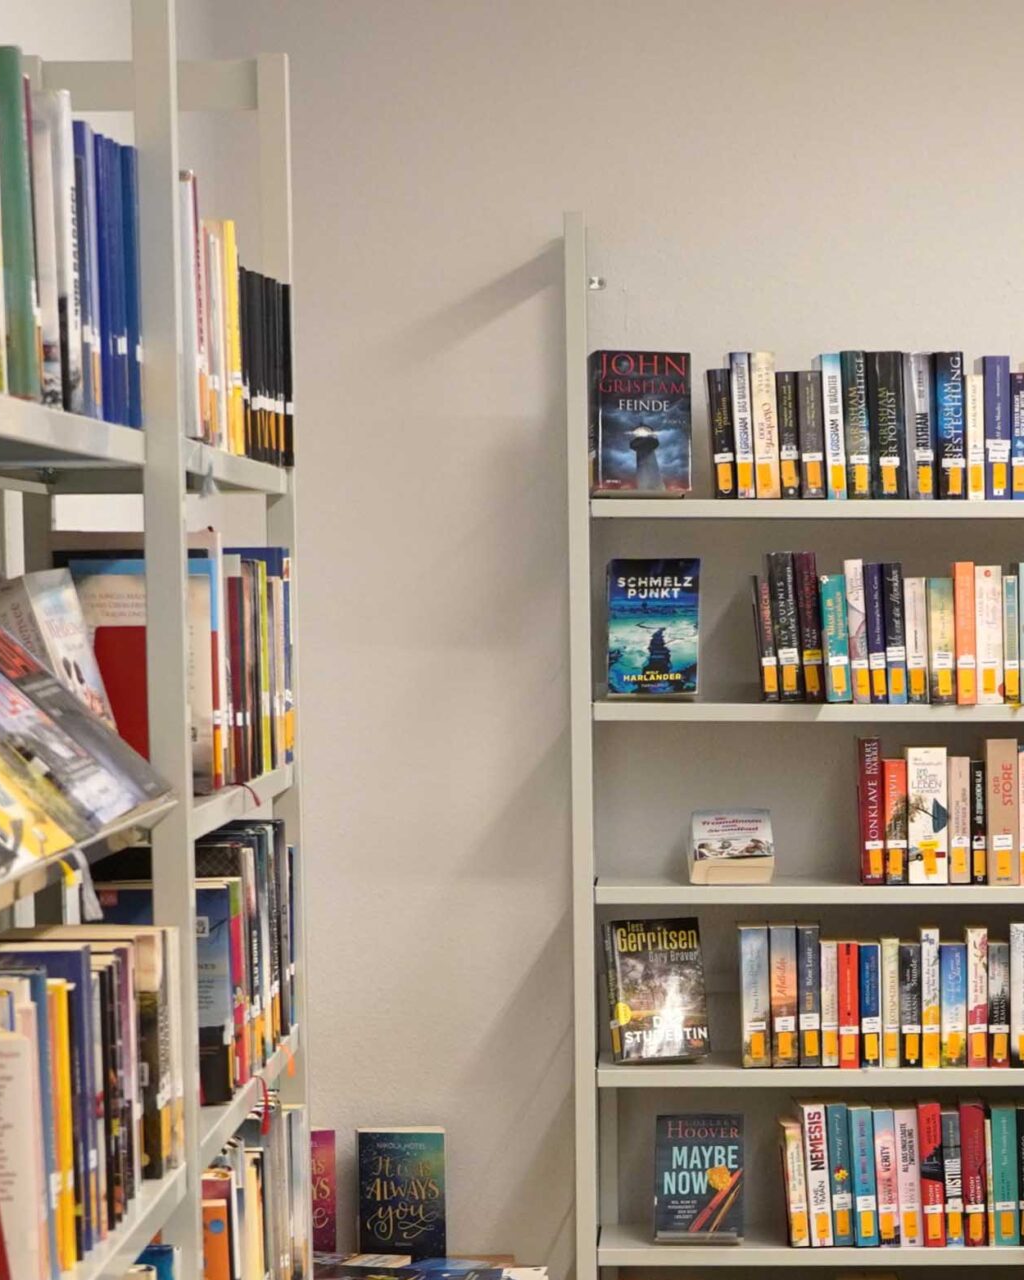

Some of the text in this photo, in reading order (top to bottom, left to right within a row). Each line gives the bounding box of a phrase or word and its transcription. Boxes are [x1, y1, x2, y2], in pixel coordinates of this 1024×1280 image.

[601, 353, 686, 379] JOHN
[599, 379, 685, 395] GRISHAM
[618, 399, 670, 412] FEINDE
[848, 386, 859, 444] GRISHAM
[877, 386, 889, 444] GRISHAM
[886, 390, 896, 441] POLIZIST
[943, 383, 954, 439] GRISHAM
[738, 417, 750, 450] GRISHAM
[829, 419, 839, 451] GRISHAM
[618, 576, 693, 588] SCHMELZ
[627, 587, 681, 599] PUNKT
[623, 673, 682, 682] HARLANDER
[911, 780, 942, 789] LEBEN
[1001, 763, 1013, 806] STORE
[868, 780, 878, 842] ONKLAVE
[617, 926, 697, 953] Gerritsen
[627, 922, 644, 932] Tess
[648, 950, 698, 963] Gary Braver
[805, 946, 813, 968] Leute
[805, 970, 813, 987] Böse
[909, 959, 918, 987] Stunde
[668, 1121, 740, 1138] HOOVER
[807, 1111, 825, 1172] NEMESIS
[900, 1123, 908, 1152] UNGESAGTE
[403, 1142, 426, 1150] HOTEL
[672, 1145, 739, 1169] MAYBE
[372, 1156, 395, 1177] It
[880, 1146, 891, 1173] VERITY
[663, 1171, 708, 1195] NOW
[946, 1159, 961, 1197] WISTING
